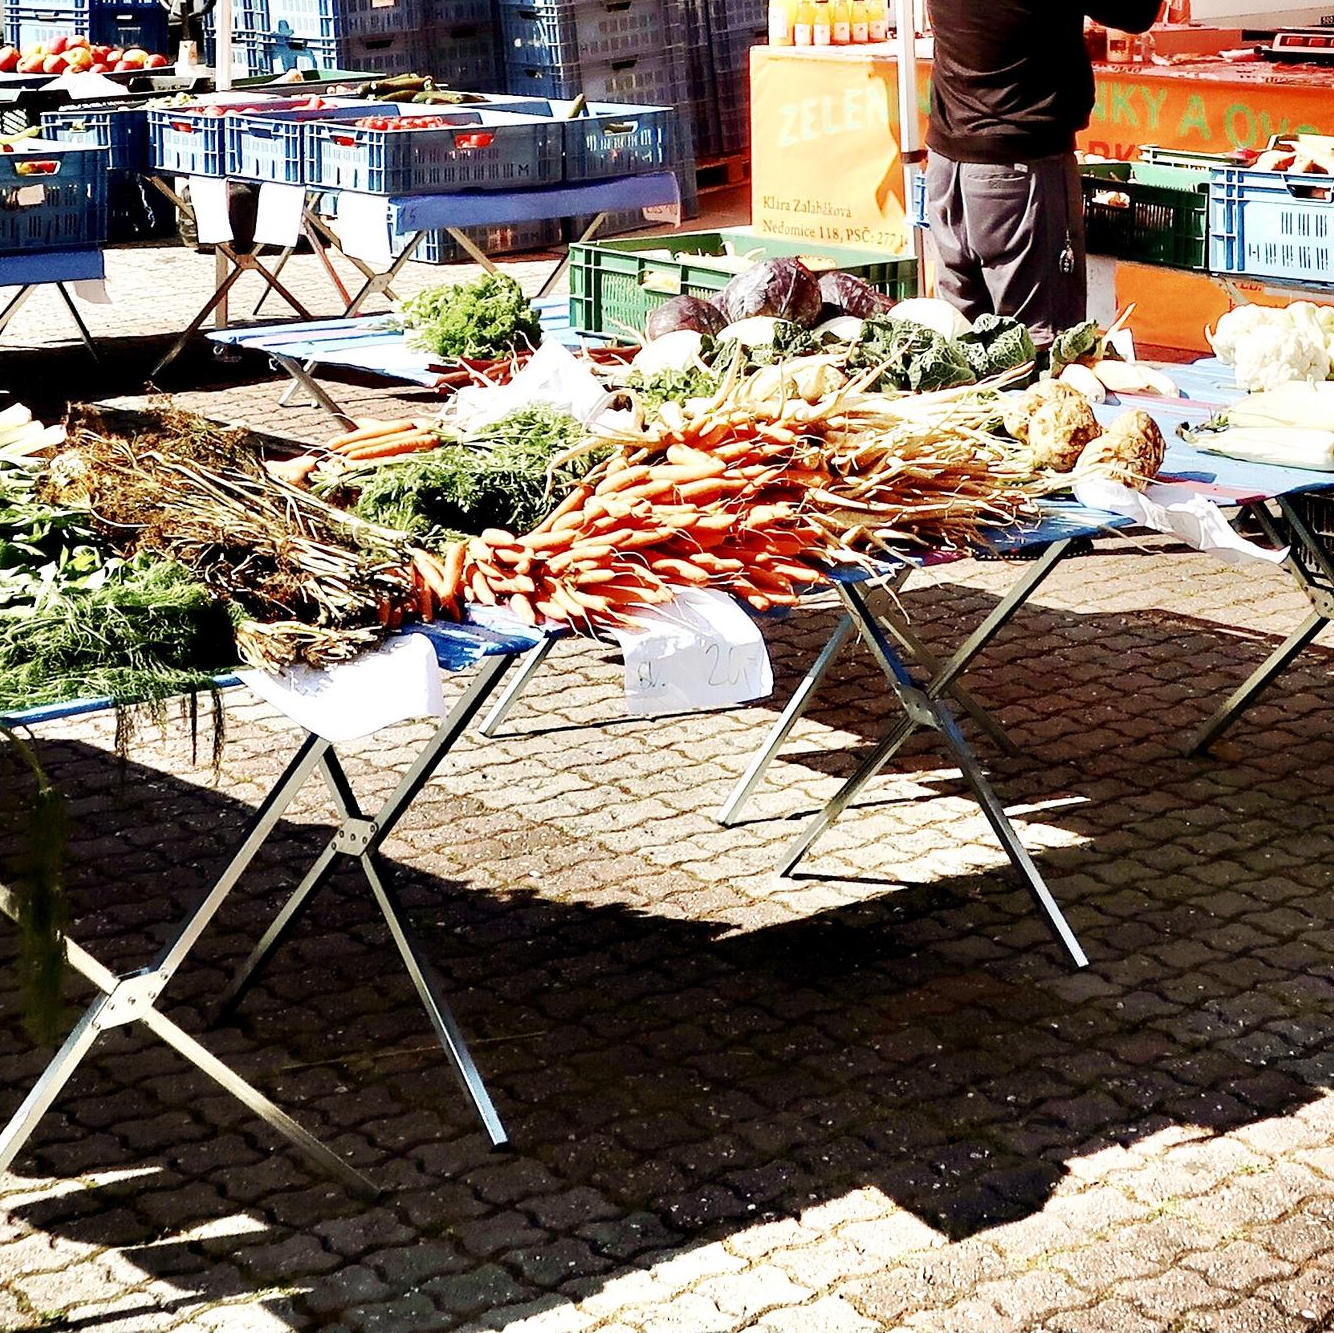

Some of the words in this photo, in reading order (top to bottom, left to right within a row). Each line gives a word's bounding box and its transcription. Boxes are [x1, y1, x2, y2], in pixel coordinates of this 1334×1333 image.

[1179, 94, 1211, 140] A
[763, 195, 791, 212] Klára
[763, 219, 816, 238] Nedomice
[819, 226, 844, 244] 118,
